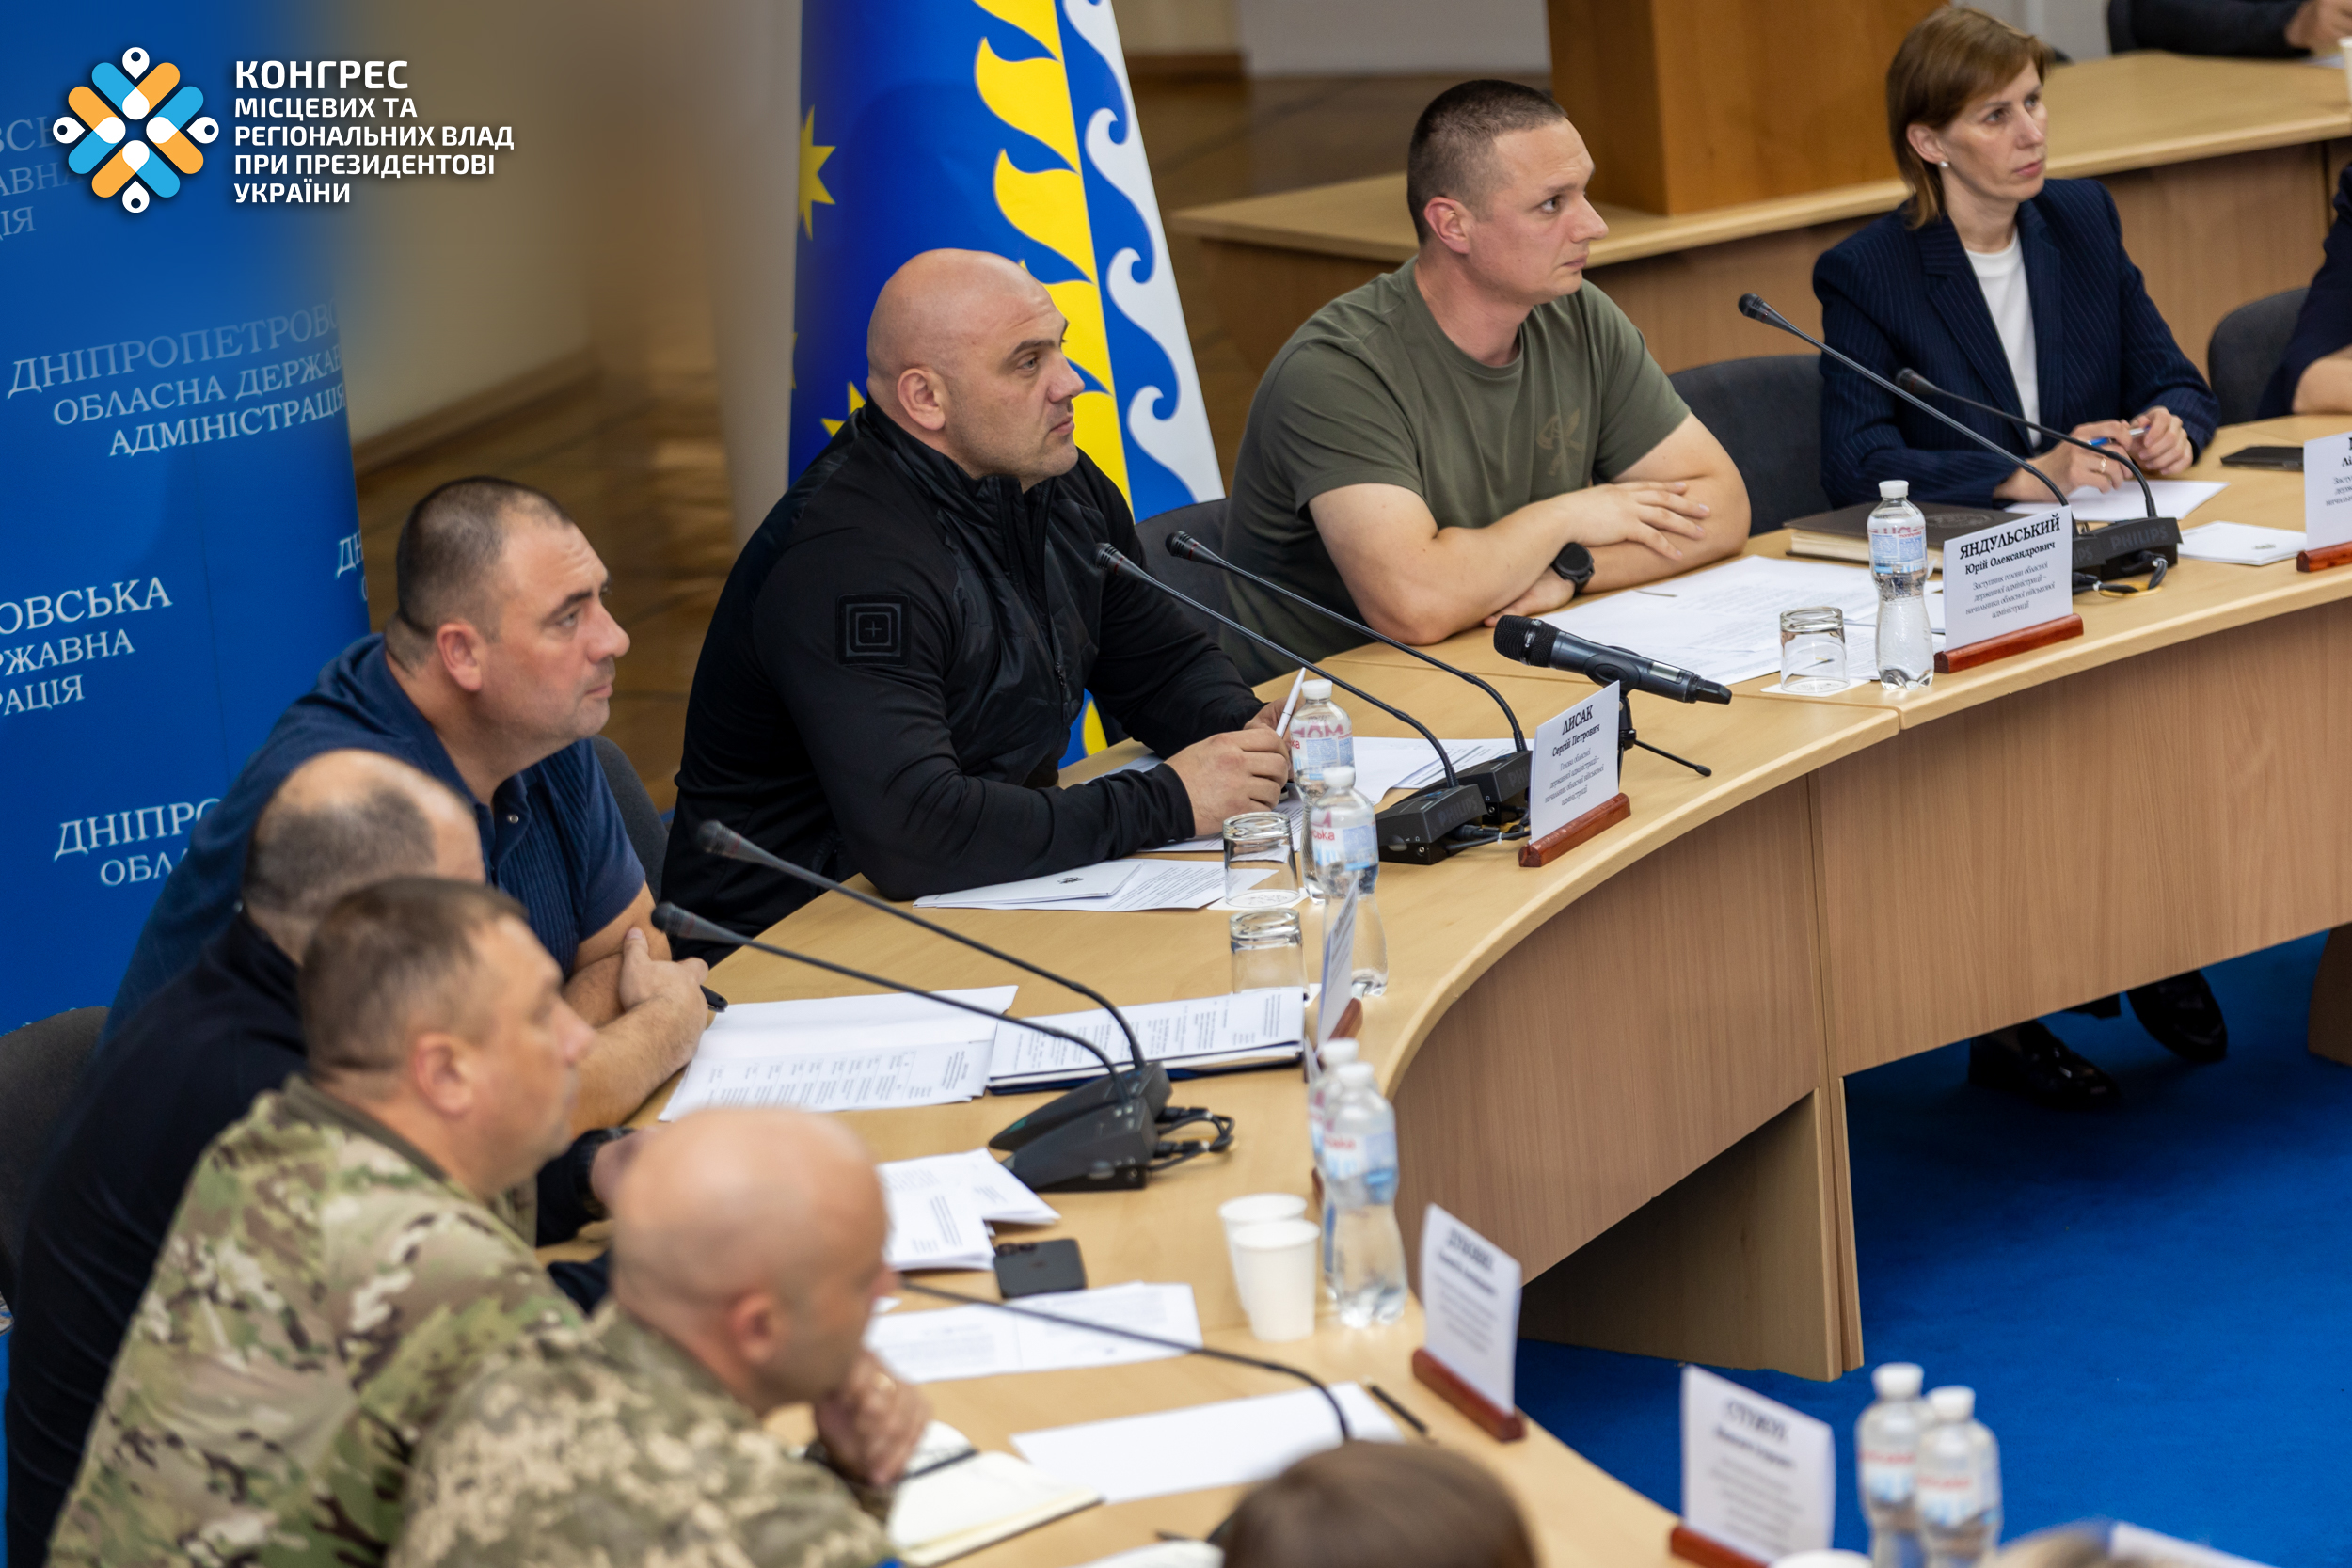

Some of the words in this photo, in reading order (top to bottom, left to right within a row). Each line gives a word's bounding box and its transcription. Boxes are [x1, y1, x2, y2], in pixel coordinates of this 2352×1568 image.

[0, 205, 37, 242] ІЯ
[54, 375, 228, 425] ОБЛАСНА
[234, 343, 343, 402] ДЕРЖАВ
[109, 381, 347, 457] АДМІНІСТРАЦІЯ
[335, 531, 363, 580] ДН
[1960, 513, 2060, 560] ЯНДУЛЬСЬКИЙ
[2109, 525, 2169, 550] PHILIPS
[1964, 559, 1989, 575] Юрій
[1990, 542, 2056, 567] Олександрович
[1973, 575, 2005, 591] Заступник
[2024, 561, 2049, 575] обласної
[1562, 704, 1594, 736] ЛИСАК
[1552, 736, 1572, 757] Сергій
[1572, 723, 1600, 746] Петрович
[54, 798, 221, 862] ДНІПР
[100, 848, 188, 887] ОБЛ
